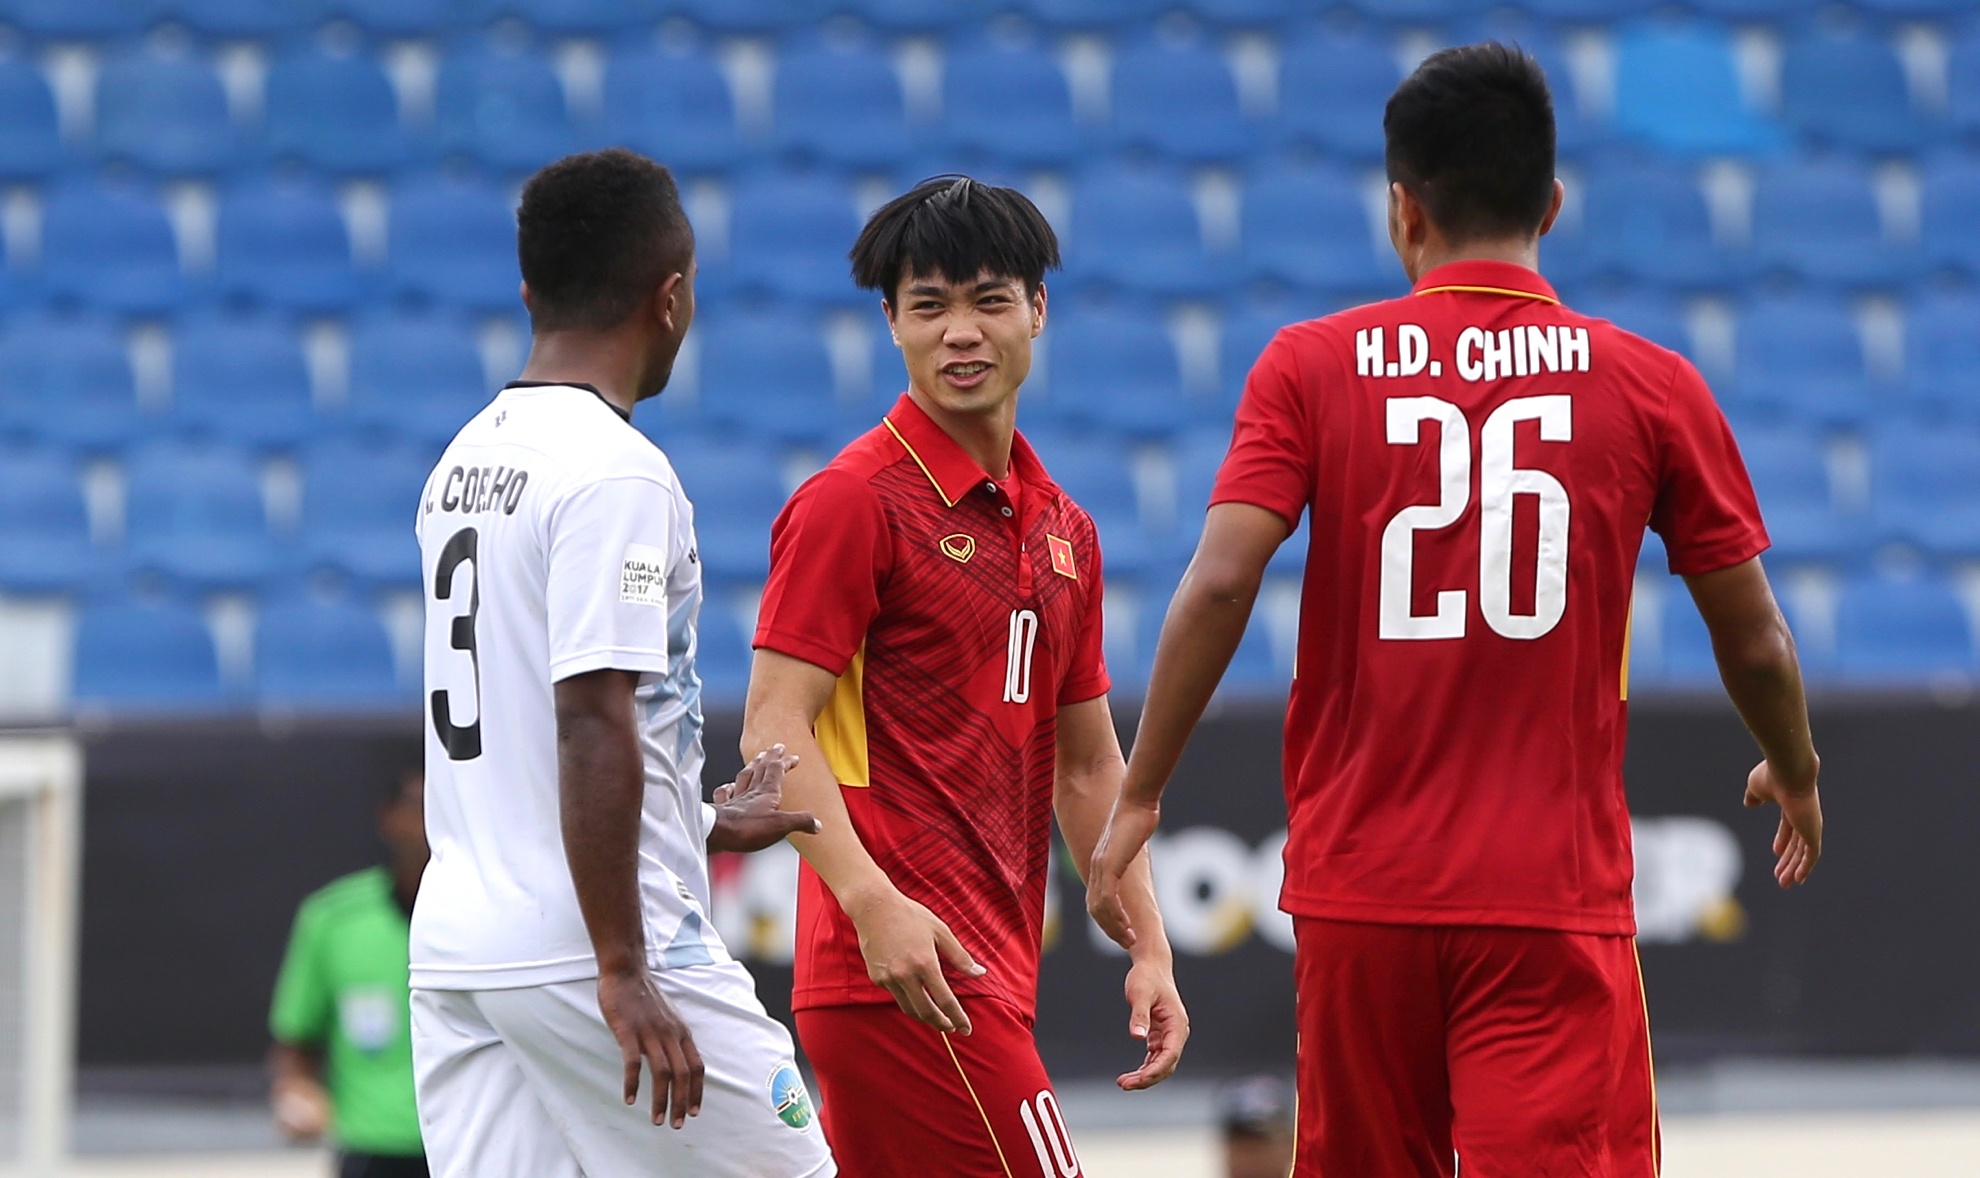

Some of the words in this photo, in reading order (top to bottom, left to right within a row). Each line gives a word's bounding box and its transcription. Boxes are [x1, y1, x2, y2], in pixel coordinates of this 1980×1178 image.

[1355, 323, 1443, 377] H.D.
[1455, 324, 1591, 383] CHINH
[1378, 394, 1573, 640] 26
[622, 582, 649, 595] 2017
[623, 560, 660, 575] KUALA
[430, 526, 482, 761] 3
[1002, 608, 1039, 704] 10
[1019, 1088, 1080, 1178] 10
